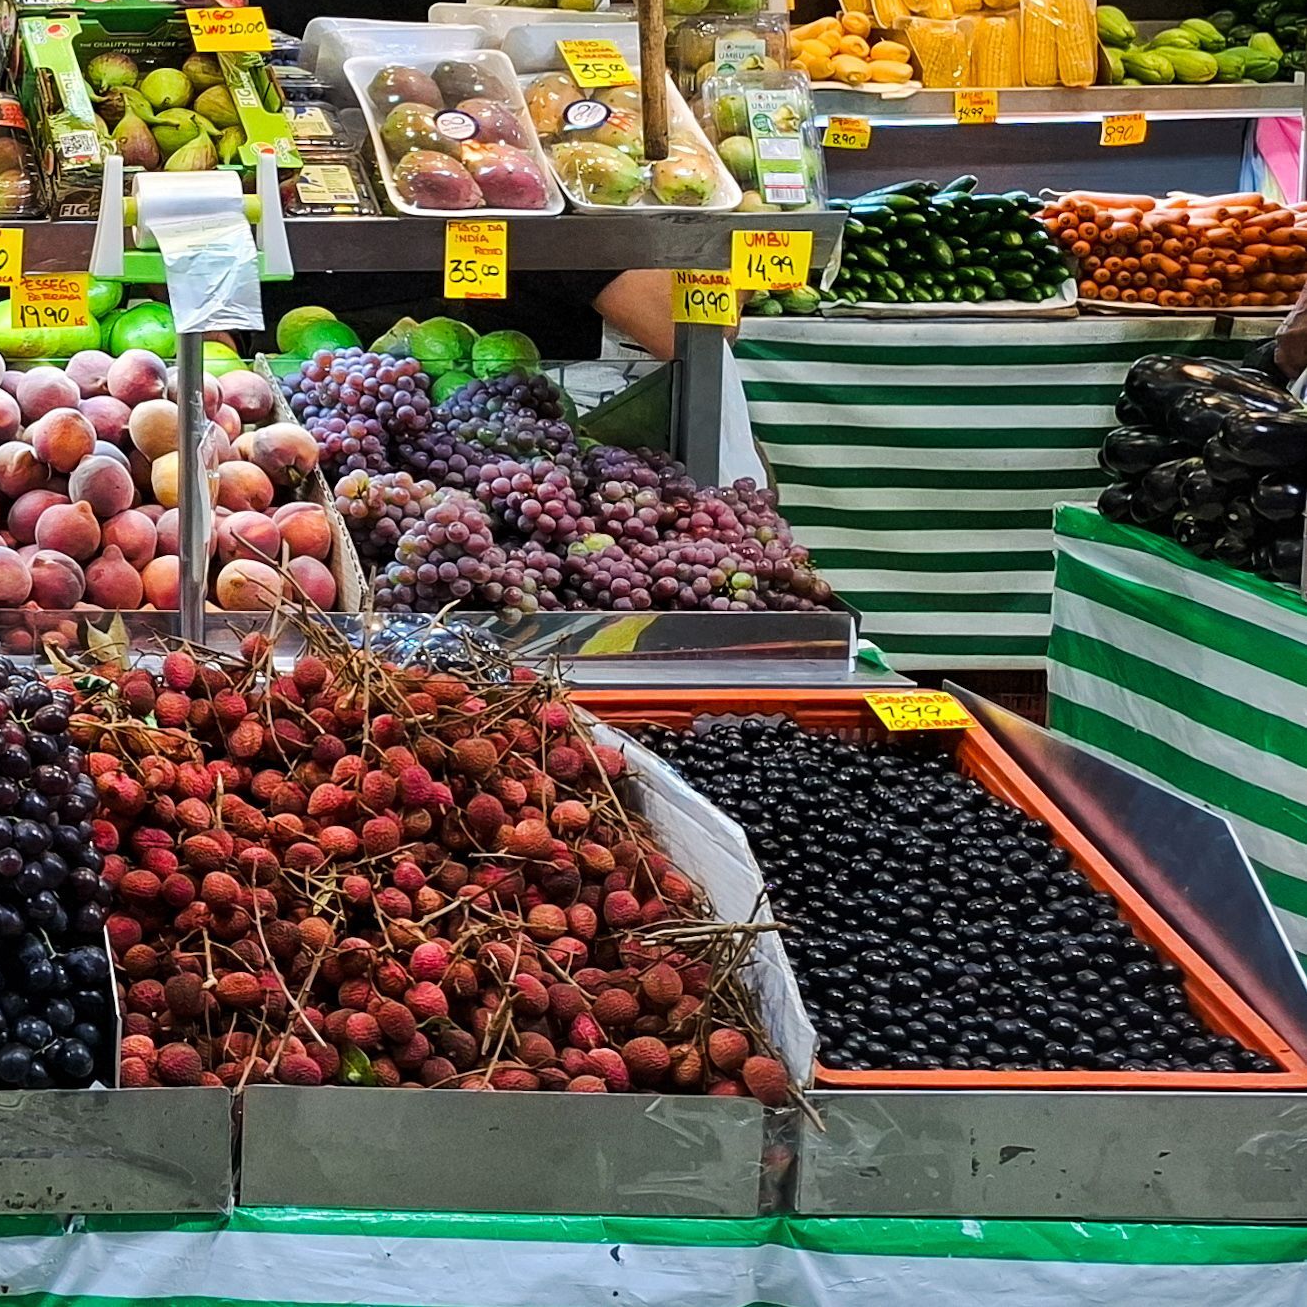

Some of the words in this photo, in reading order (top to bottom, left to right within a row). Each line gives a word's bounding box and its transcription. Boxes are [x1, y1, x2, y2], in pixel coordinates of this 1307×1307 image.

[198, 9, 234, 22] FIGO
[93, 41, 127, 49] QUALITY
[718, 52, 745, 60] UMBU
[487, 224, 504, 232] DA
[744, 232, 790, 247] UMBU
